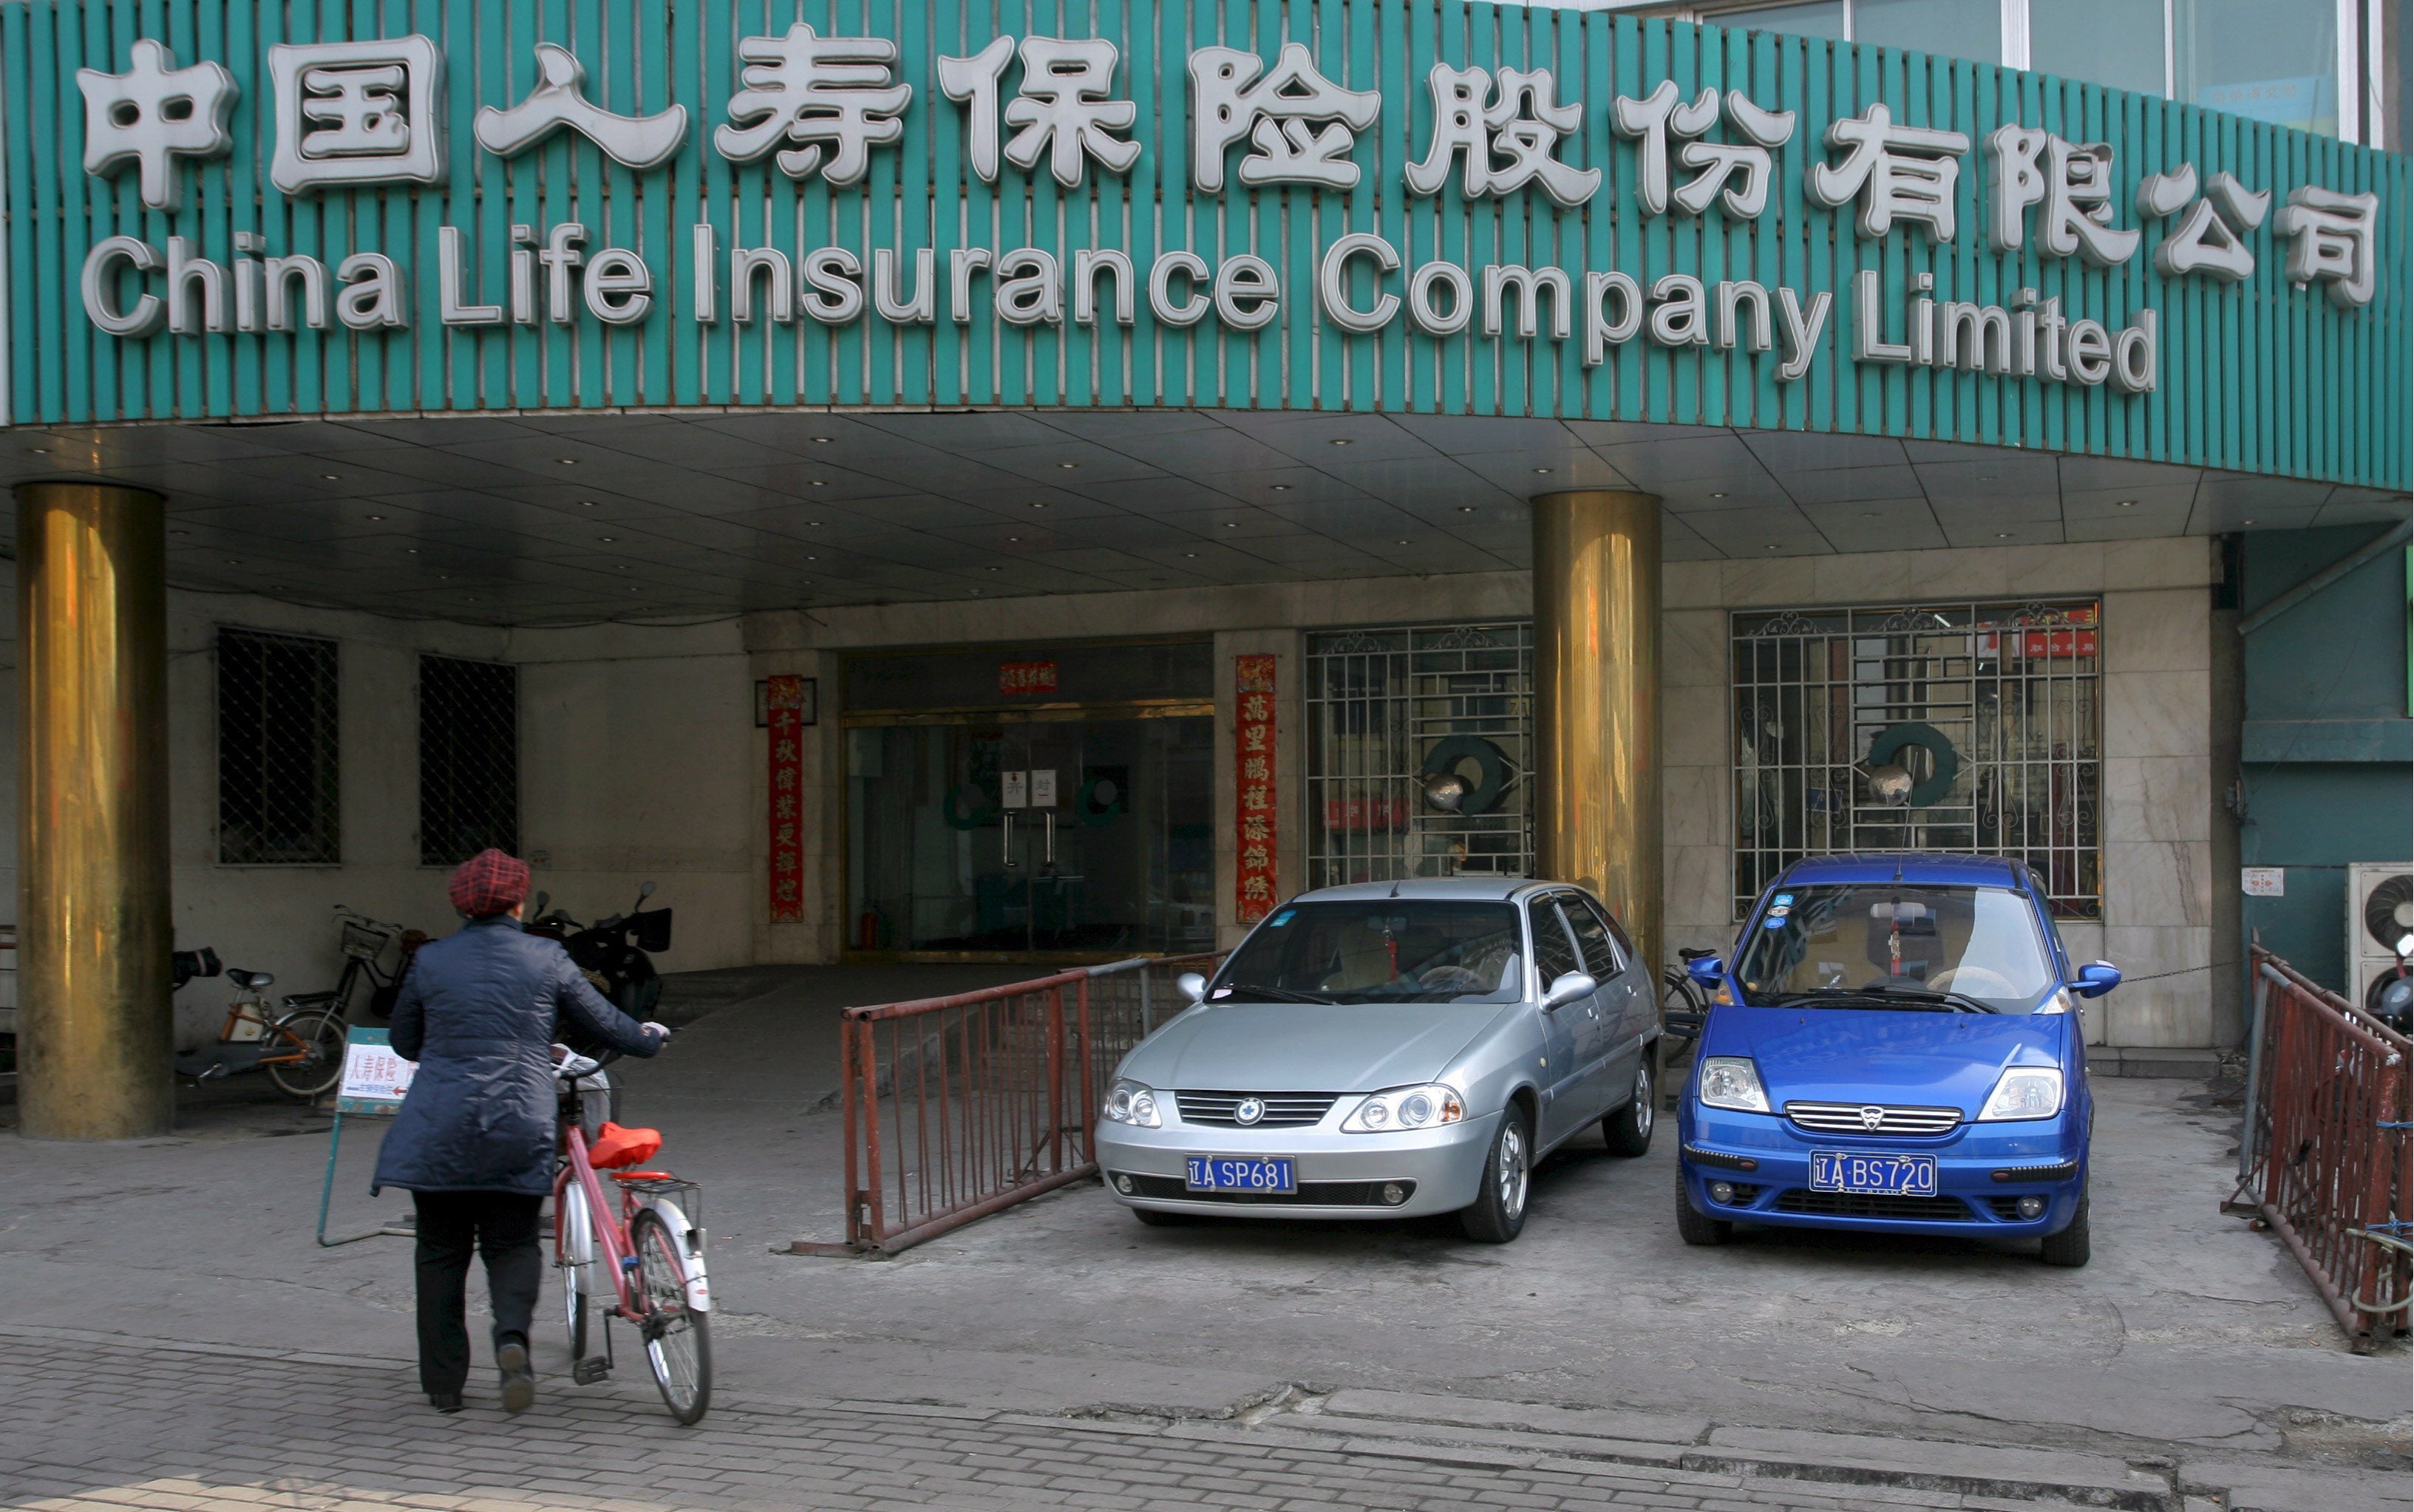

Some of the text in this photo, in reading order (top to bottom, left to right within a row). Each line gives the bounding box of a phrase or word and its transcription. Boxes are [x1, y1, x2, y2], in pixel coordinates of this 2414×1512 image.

[76, 21, 2380, 308] 中国人寿保险股份有限公司
[81, 222, 2158, 395] China Life Insurance Company Limited
